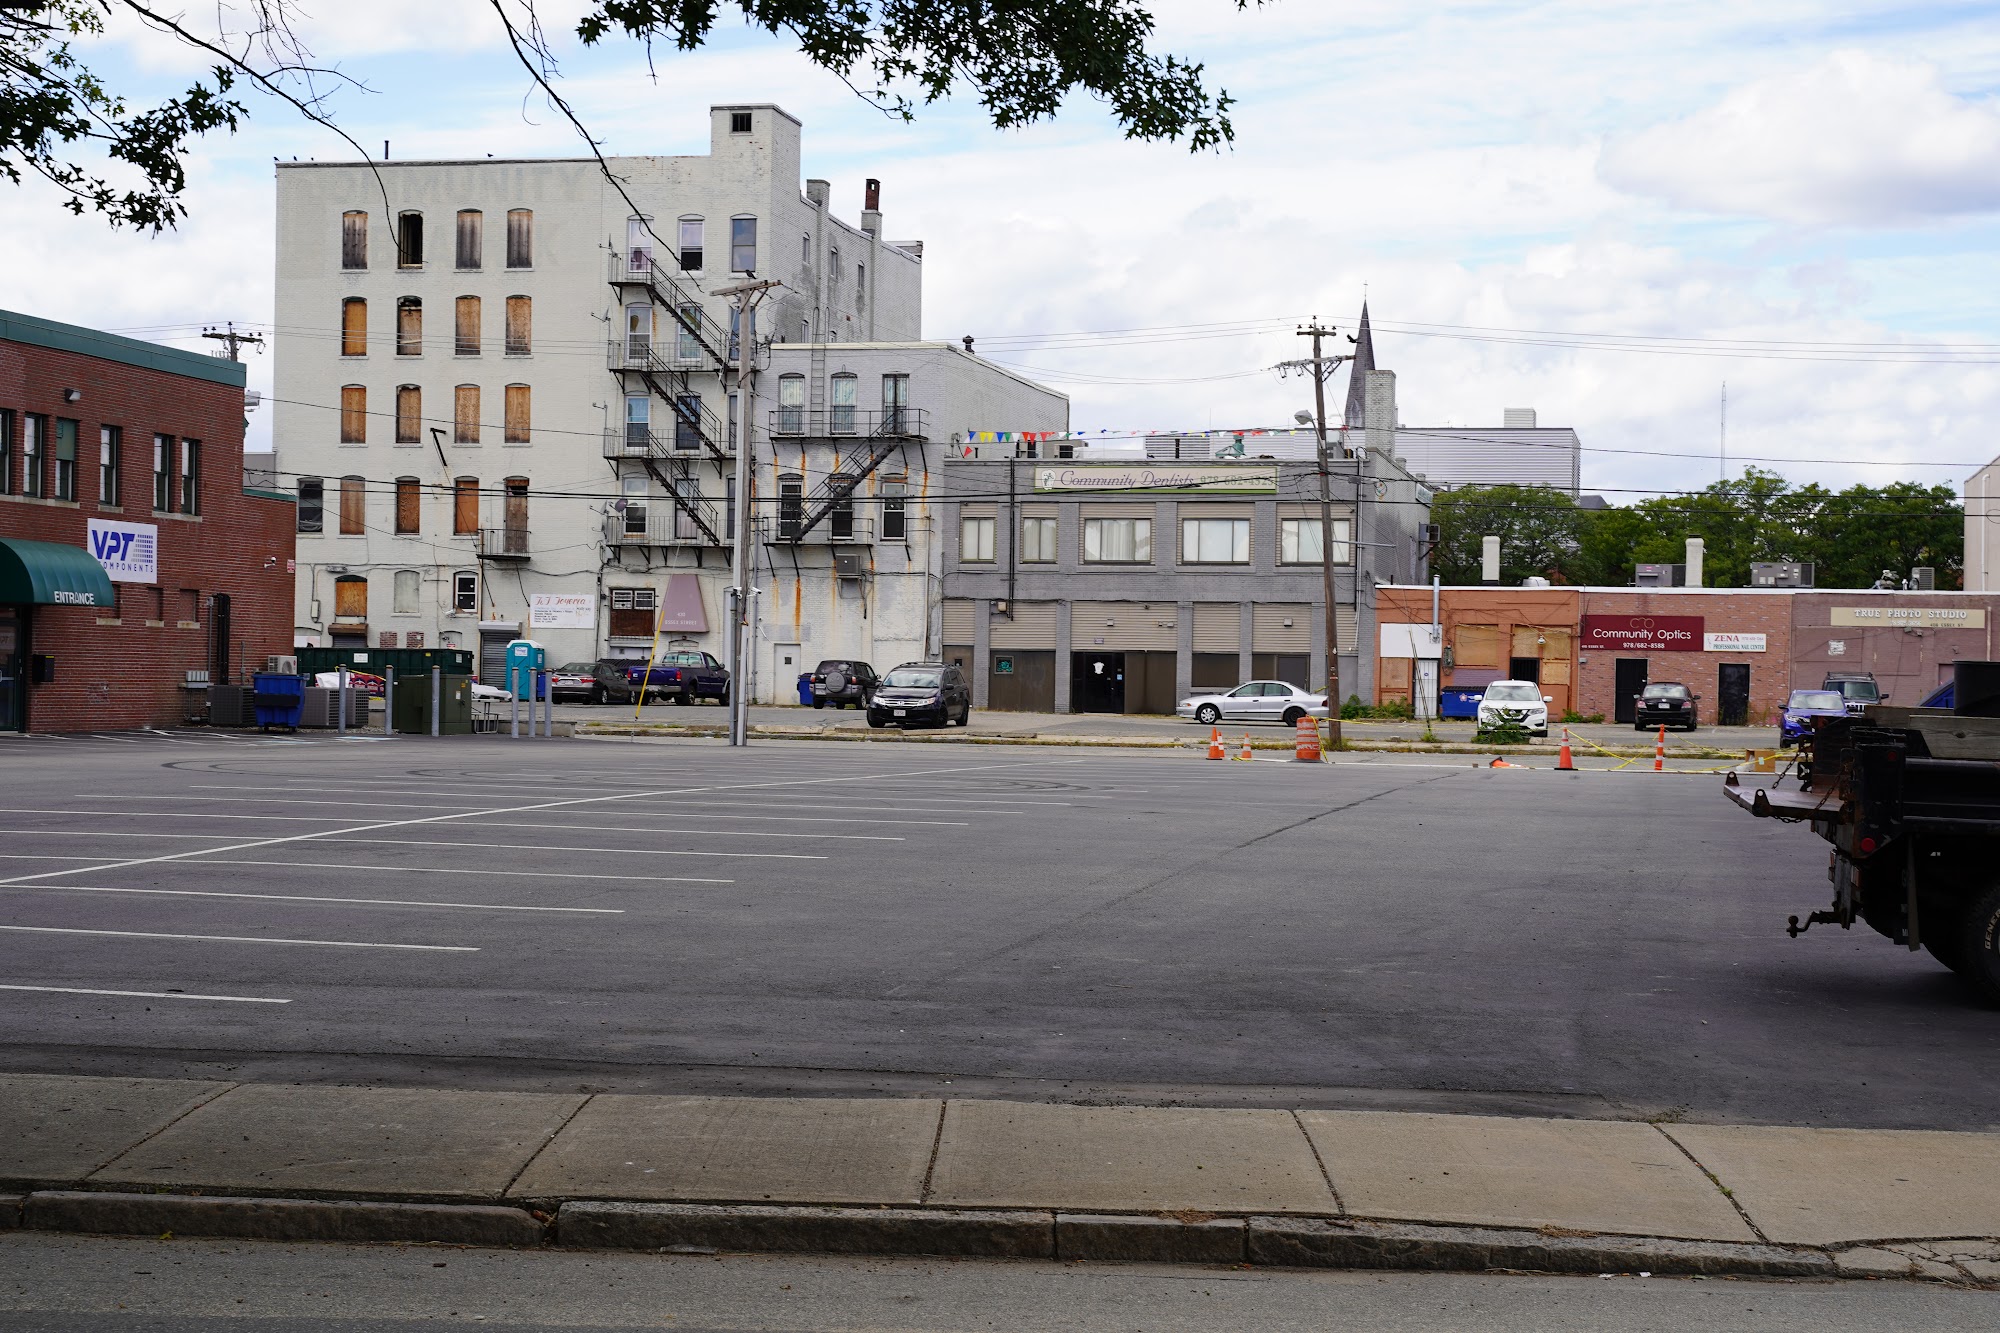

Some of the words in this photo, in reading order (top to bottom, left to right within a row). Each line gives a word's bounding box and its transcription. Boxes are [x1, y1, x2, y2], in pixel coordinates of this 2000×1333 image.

[1060, 470, 1137, 488] Community
[1140, 470, 1194, 486] Dentists
[91, 529, 136, 561] VPT
[100, 561, 154, 573] OMPONENTS
[54, 591, 95, 605] ENTRANCE
[1854, 609, 1881, 617] TRUE
[1887, 610, 1922, 618] PHOTO
[1928, 610, 1968, 619] STUDIO
[1592, 628, 1654, 640] Community
[1657, 629, 1692, 641] Optics
